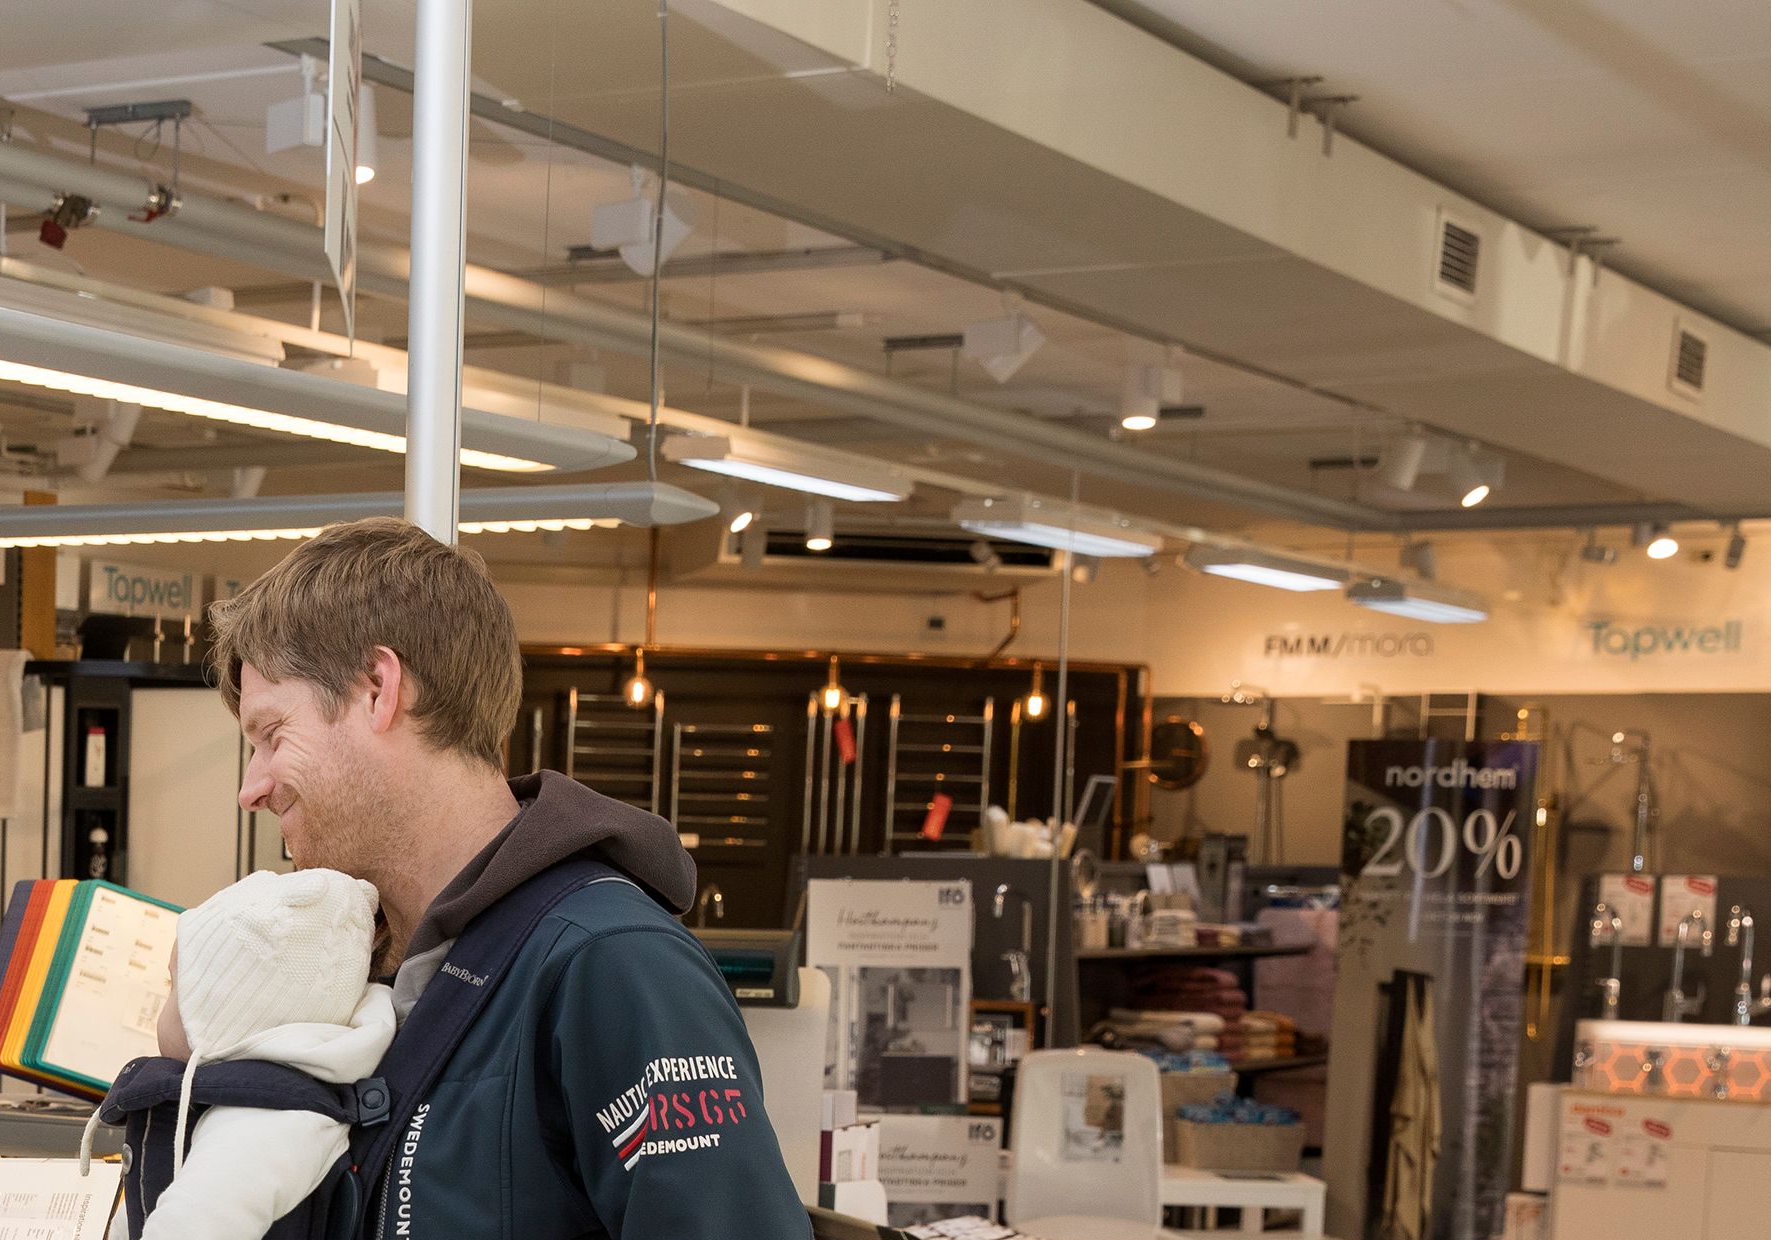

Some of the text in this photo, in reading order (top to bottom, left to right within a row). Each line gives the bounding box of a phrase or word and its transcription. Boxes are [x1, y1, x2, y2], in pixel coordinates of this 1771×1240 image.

[1588, 620, 1743, 661] Tapwell
[1385, 758, 1517, 789] nordhem
[1360, 804, 1522, 880] 20%
[645, 1056, 737, 1087] EXPERIENCE
[596, 1077, 648, 1133] NAUTIC
